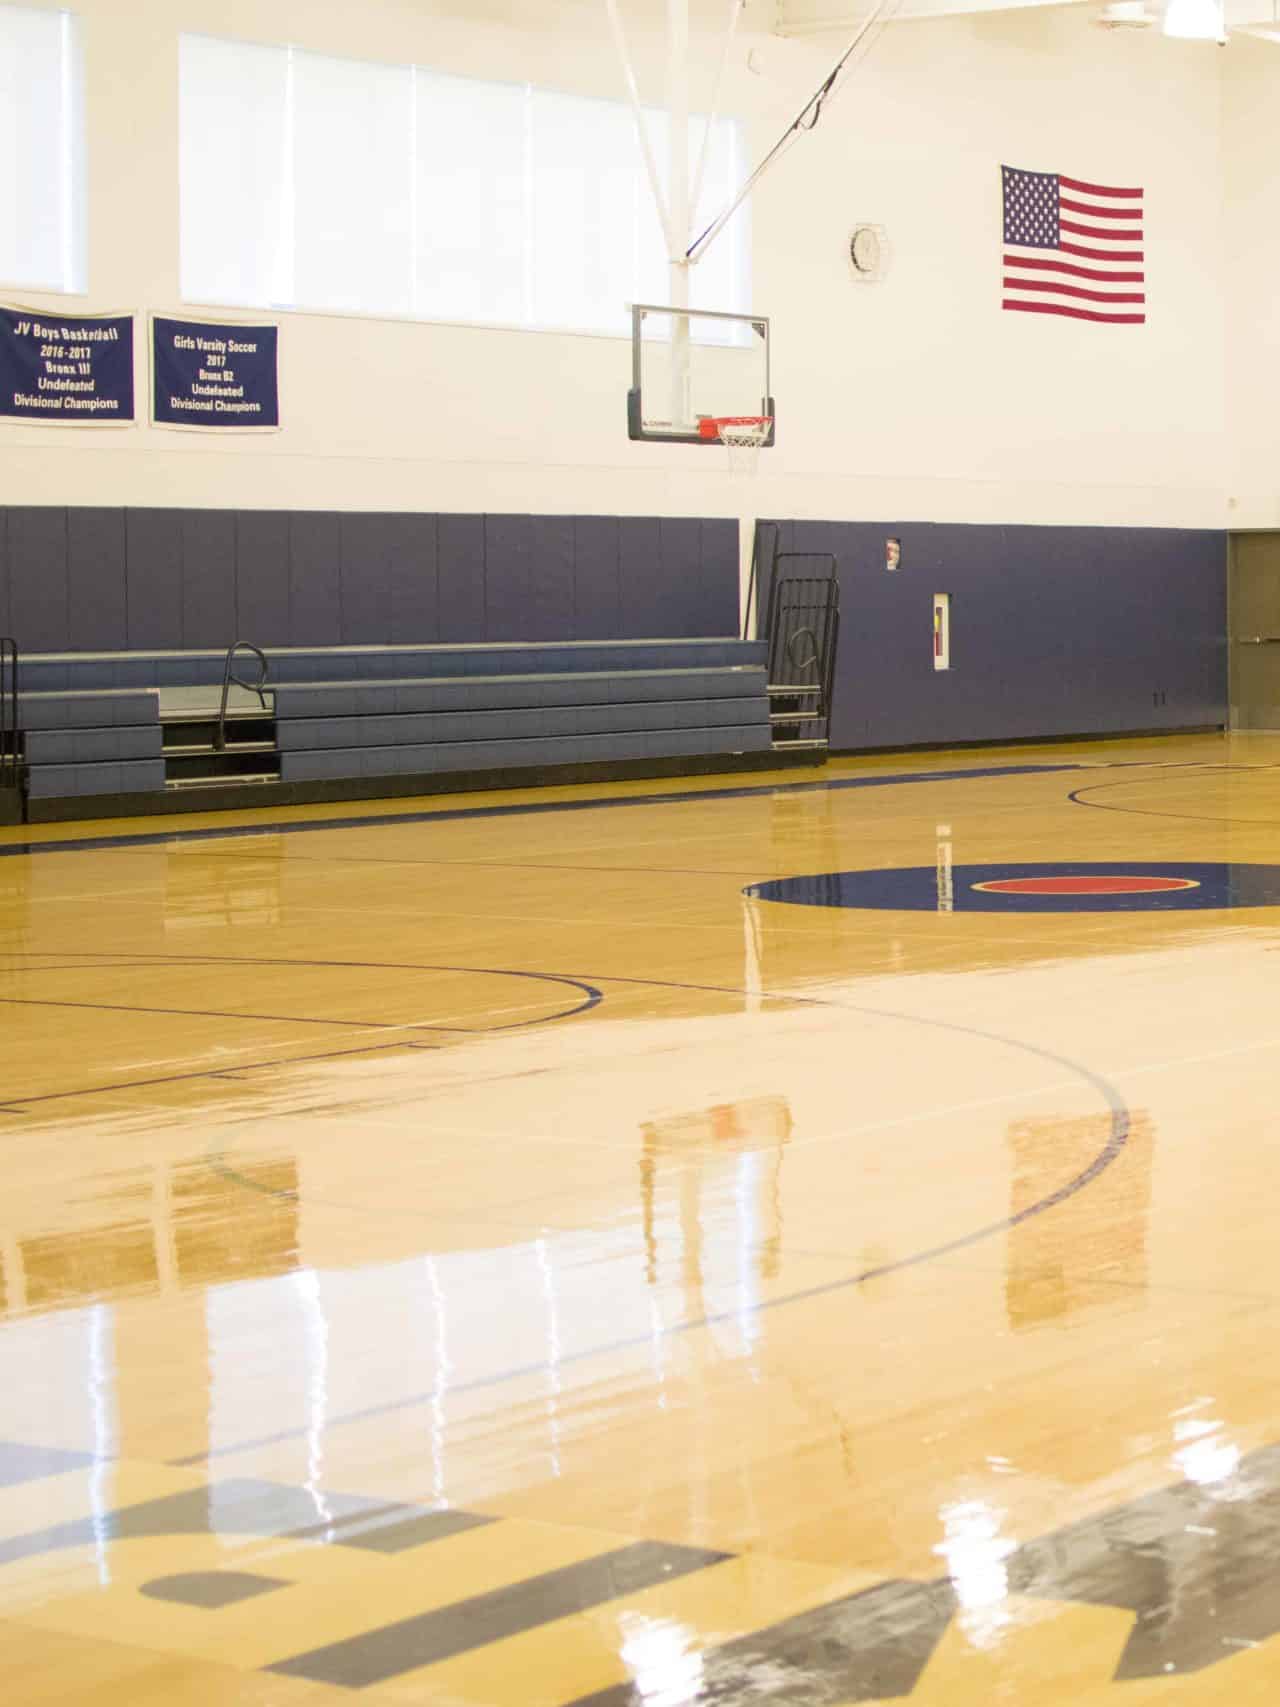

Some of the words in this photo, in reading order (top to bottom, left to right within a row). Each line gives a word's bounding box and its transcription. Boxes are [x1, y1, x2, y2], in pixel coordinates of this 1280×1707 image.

[14, 321, 31, 336] JV
[33, 324, 59, 340] Boys
[61, 326, 119, 341] Basketball
[174, 335, 195, 350] Girls
[196, 336, 227, 354] Varsity
[228, 339, 257, 354] Soccer
[207, 355, 226, 367] 2017
[45, 362, 76, 375] Bronx
[199, 370, 221, 382] Bronx
[38, 377, 95, 391] Undefeated
[191, 383, 244, 397] Undefeated
[14, 394, 62, 409] Divisional
[64, 396, 119, 412] Champions
[171, 397, 213, 411] Divisional
[215, 400, 261, 414] Champions
